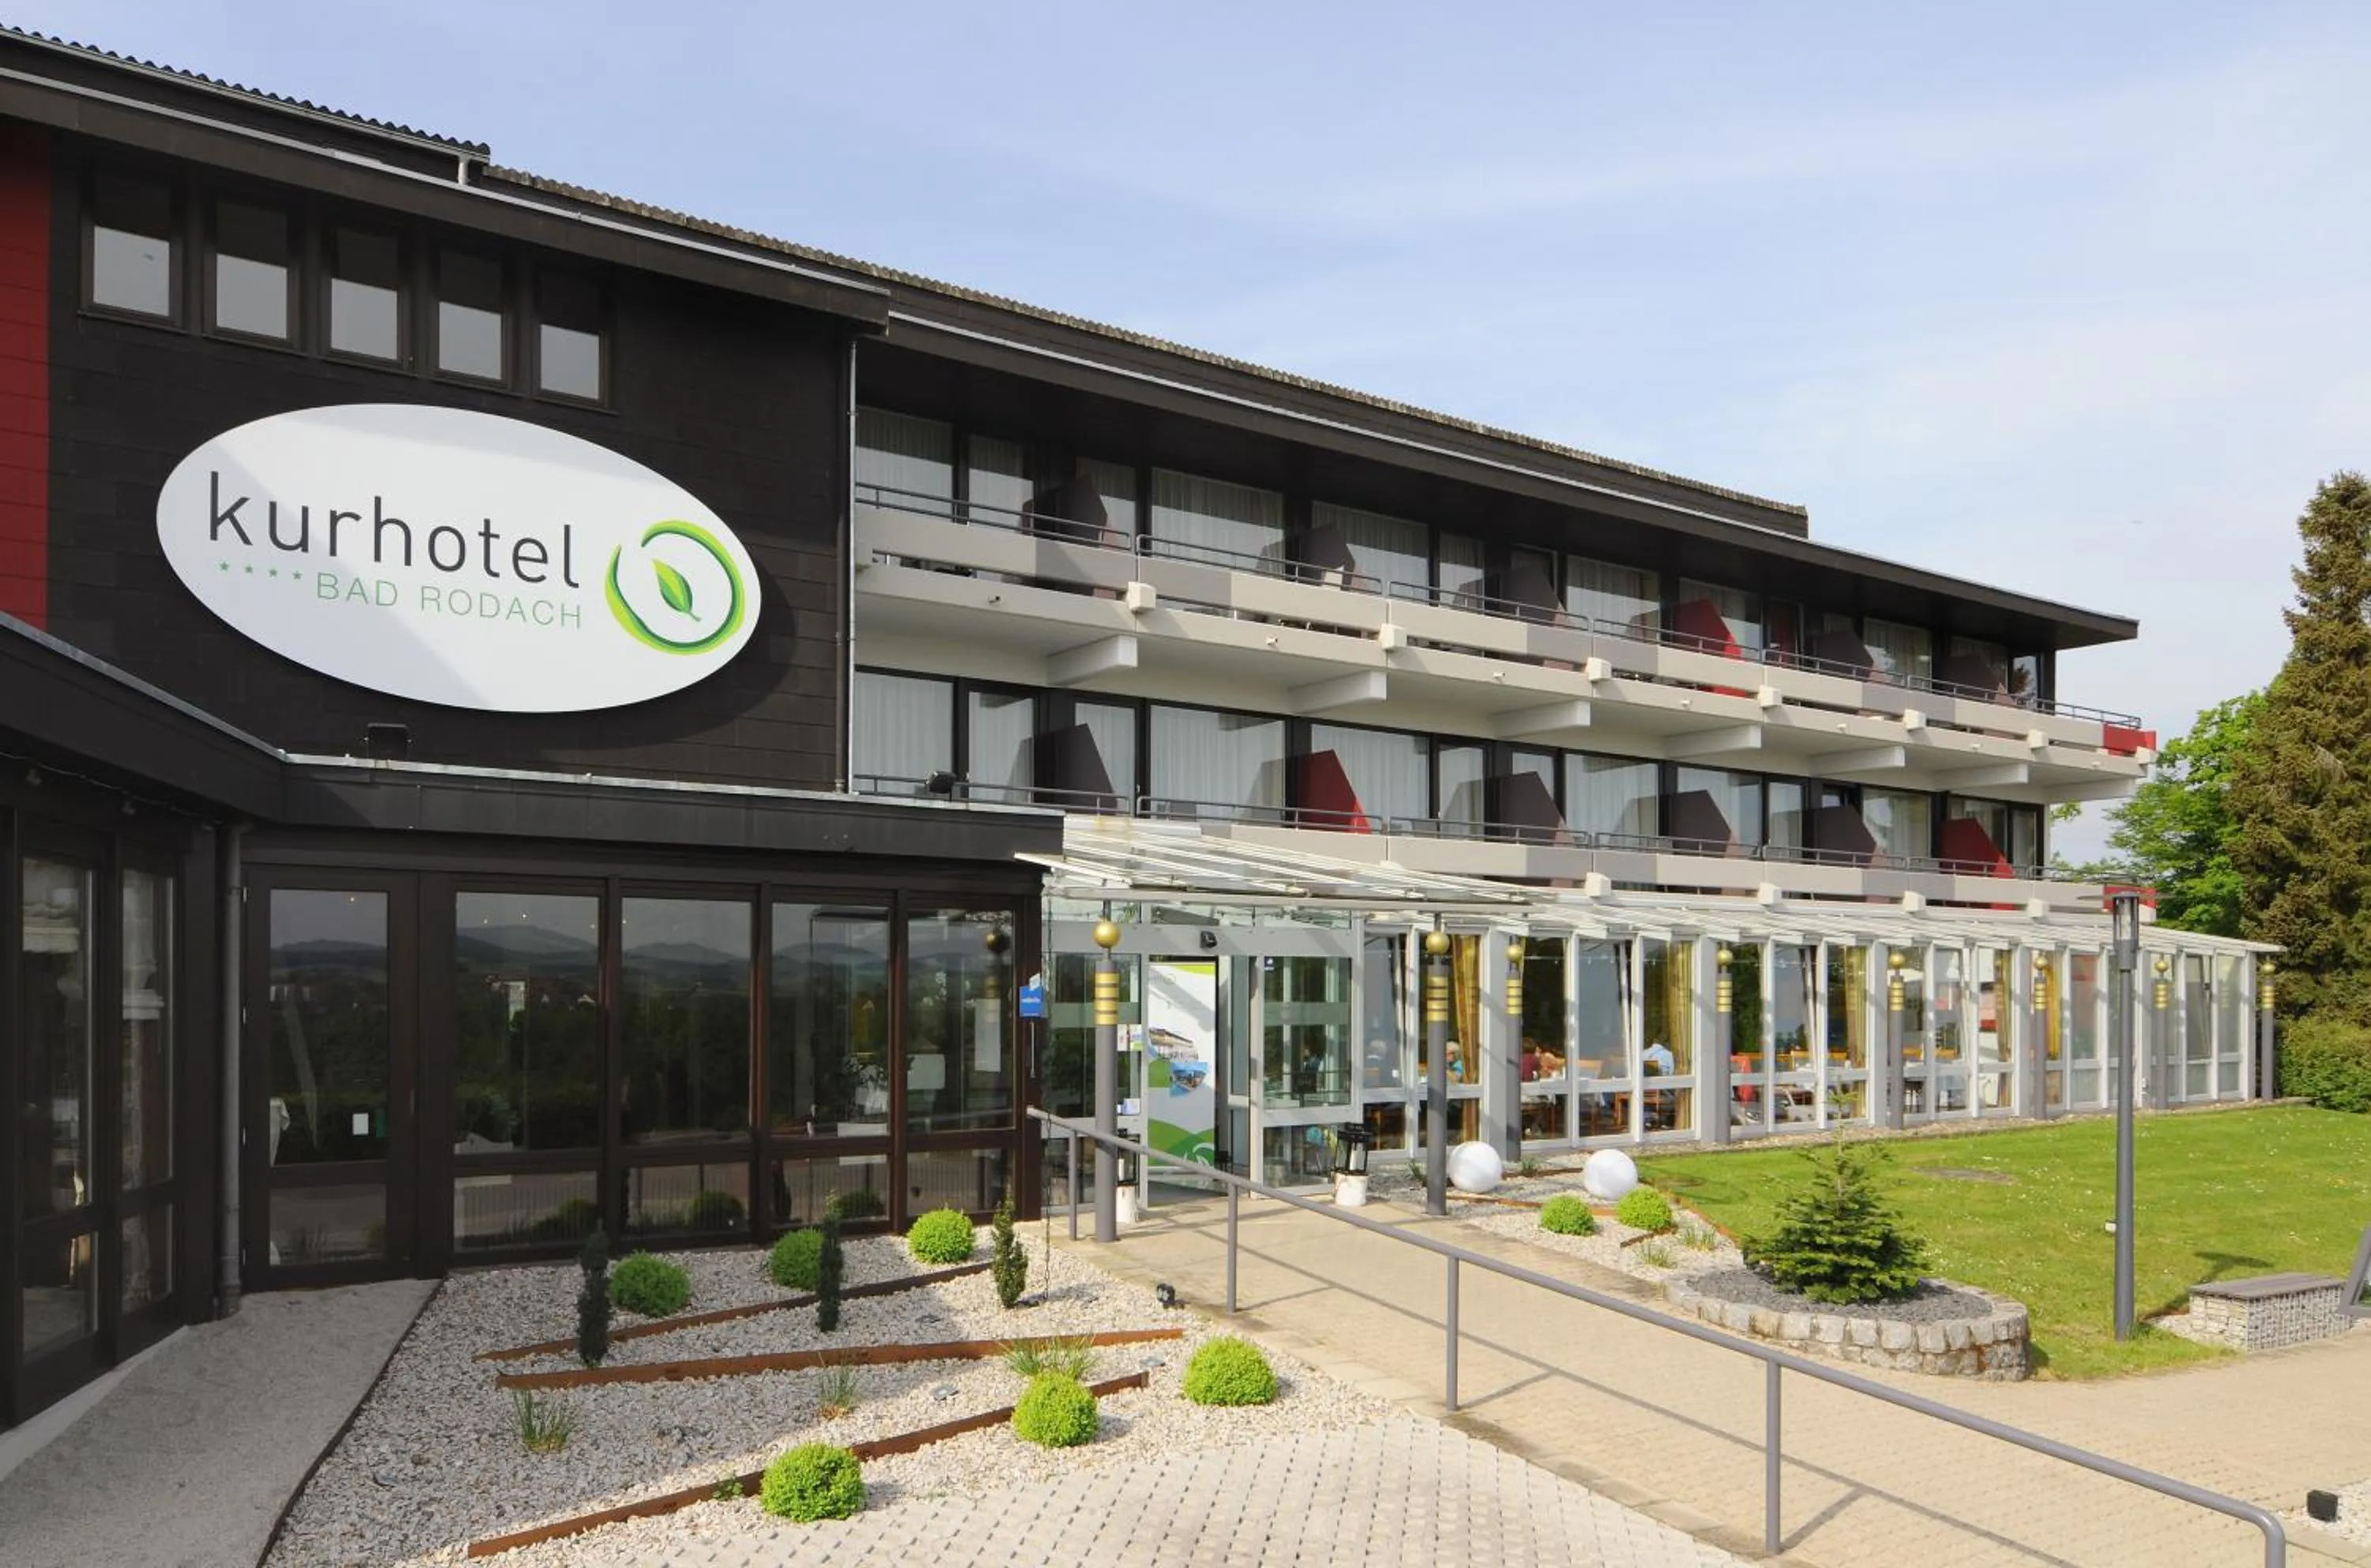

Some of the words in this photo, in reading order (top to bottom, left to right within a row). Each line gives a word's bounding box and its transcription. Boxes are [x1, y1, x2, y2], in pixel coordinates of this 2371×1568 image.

[209, 470, 580, 589] kurhotel
[318, 572, 398, 608] BAD
[421, 586, 582, 629] RODACH
